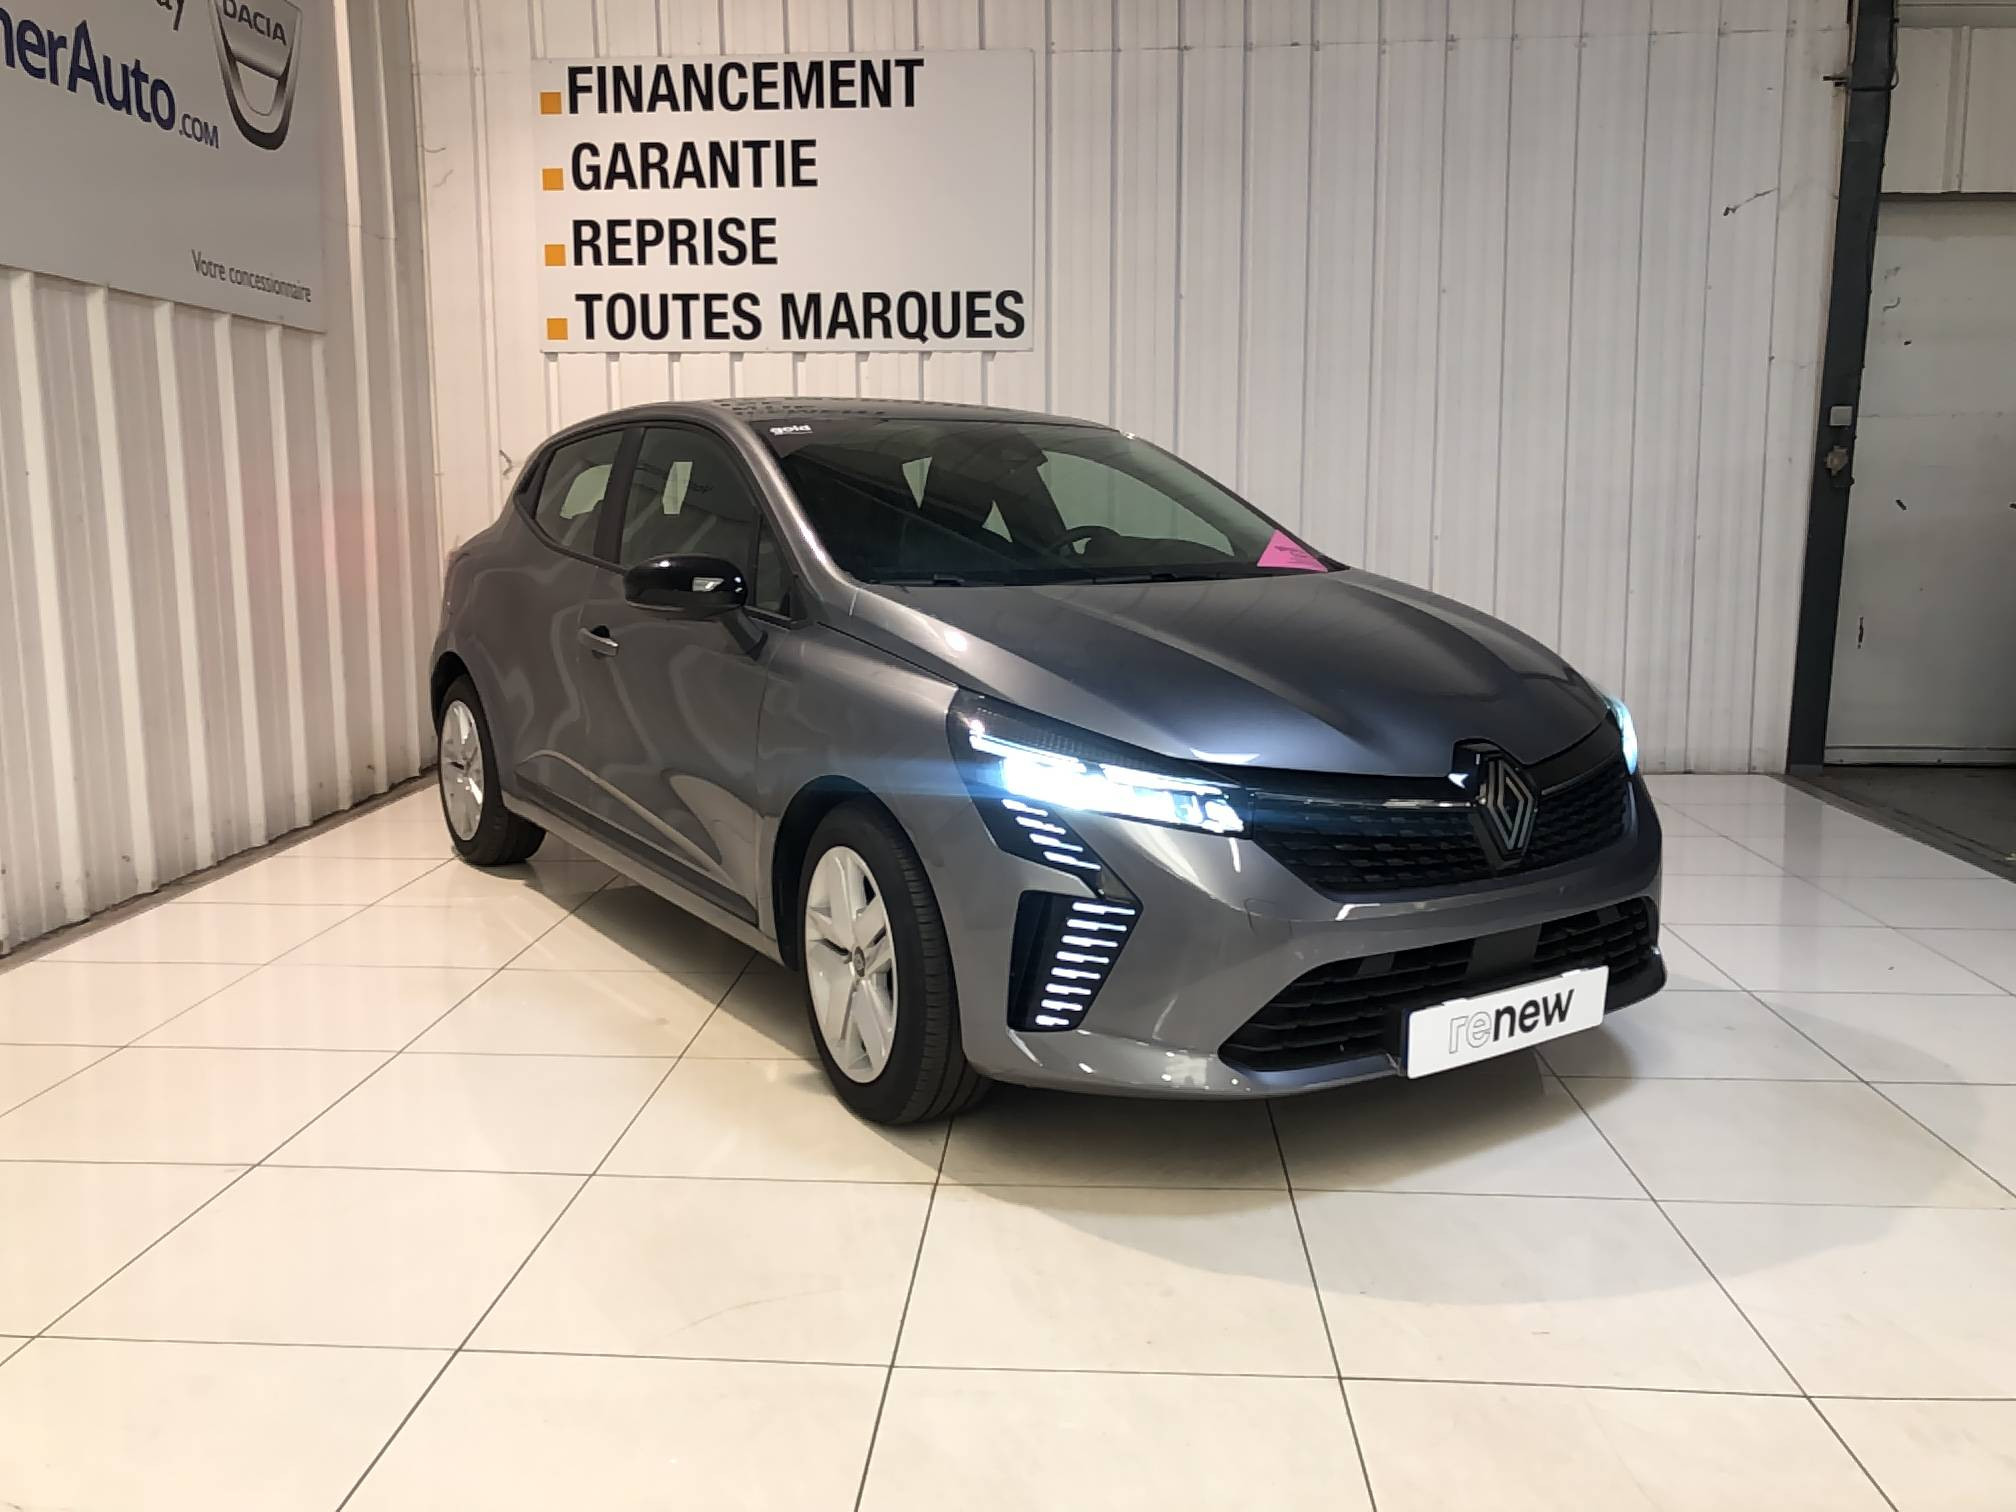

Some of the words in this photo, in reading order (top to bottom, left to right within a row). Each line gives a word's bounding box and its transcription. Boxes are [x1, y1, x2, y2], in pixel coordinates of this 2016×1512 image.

[222, 0, 287, 46] DACIA
[567, 58, 925, 114] FINANCEMENT
[571, 139, 818, 191] GARANTIE
[573, 217, 778, 267] REPRISE
[191, 249, 226, 281] Votre
[229, 267, 312, 303] concessionnaire
[575, 292, 762, 341] TOUTES
[780, 290, 1025, 343] MARQUES
[1448, 988, 1575, 1054] renew
